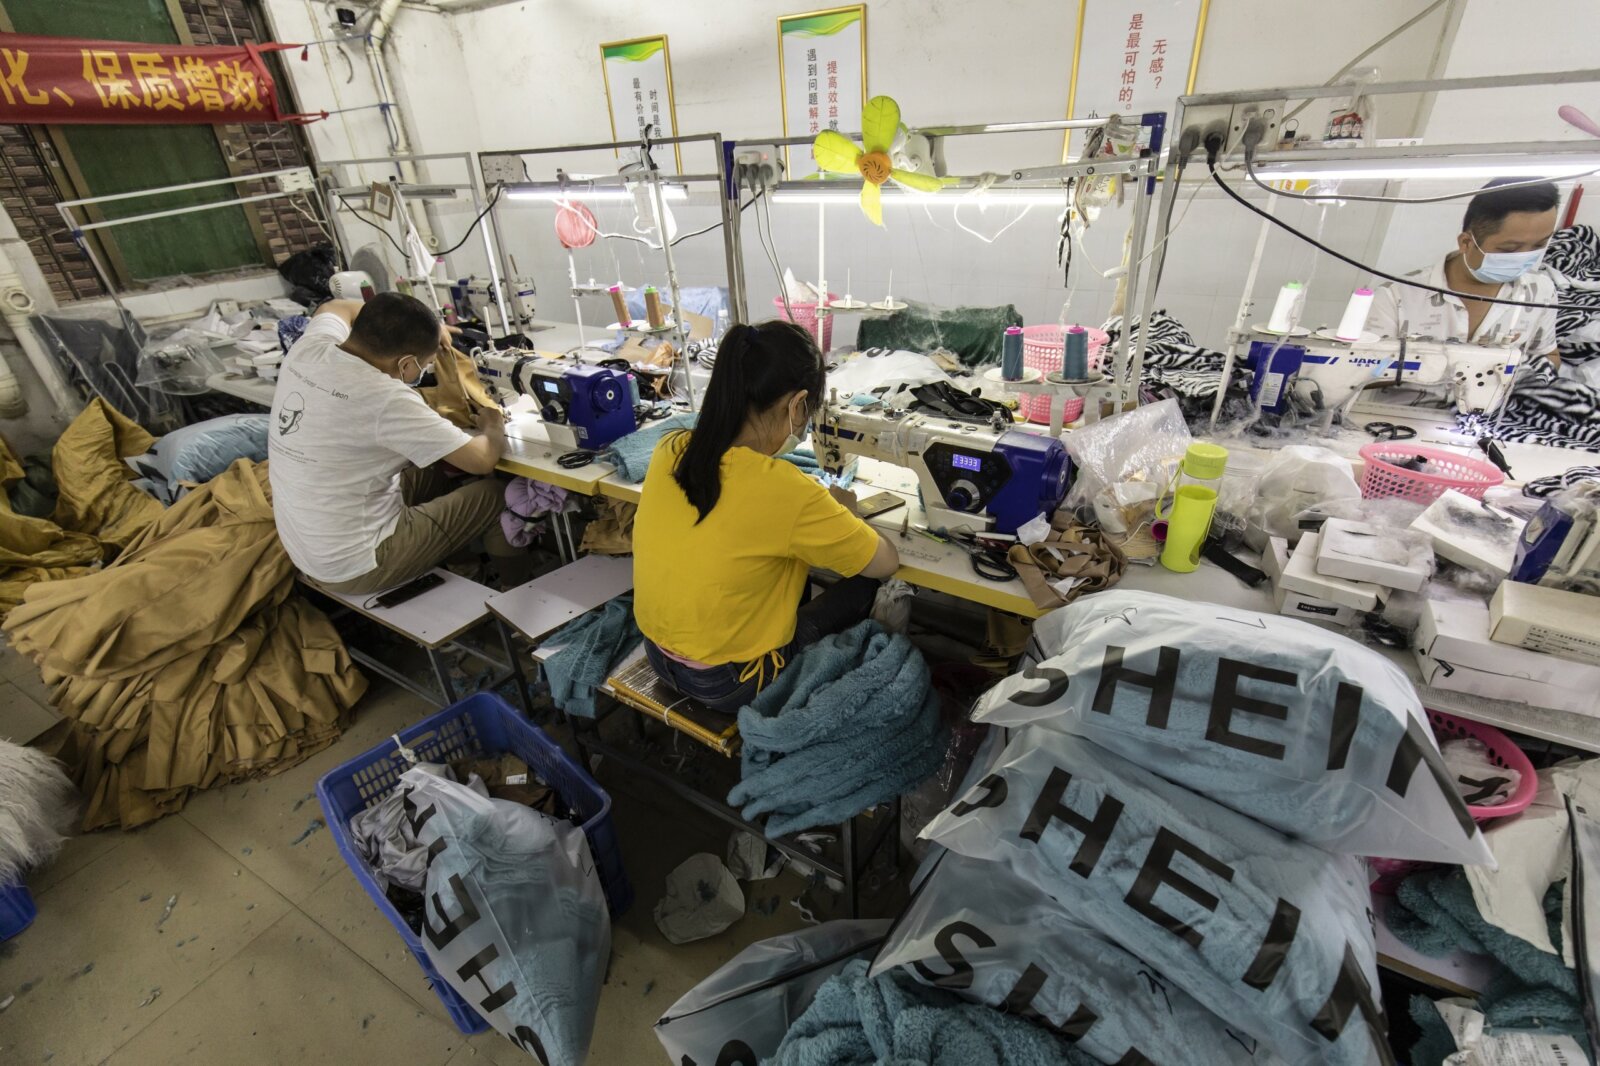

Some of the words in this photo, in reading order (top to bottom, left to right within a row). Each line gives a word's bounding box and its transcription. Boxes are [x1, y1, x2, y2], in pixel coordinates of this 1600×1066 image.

[806, 48, 819, 160] 遇到问题解决
[1118, 13, 1143, 110] 是最可怕的。
[649, 89, 664, 150] 时间是我
[1007, 644, 1477, 840] SHEIN
